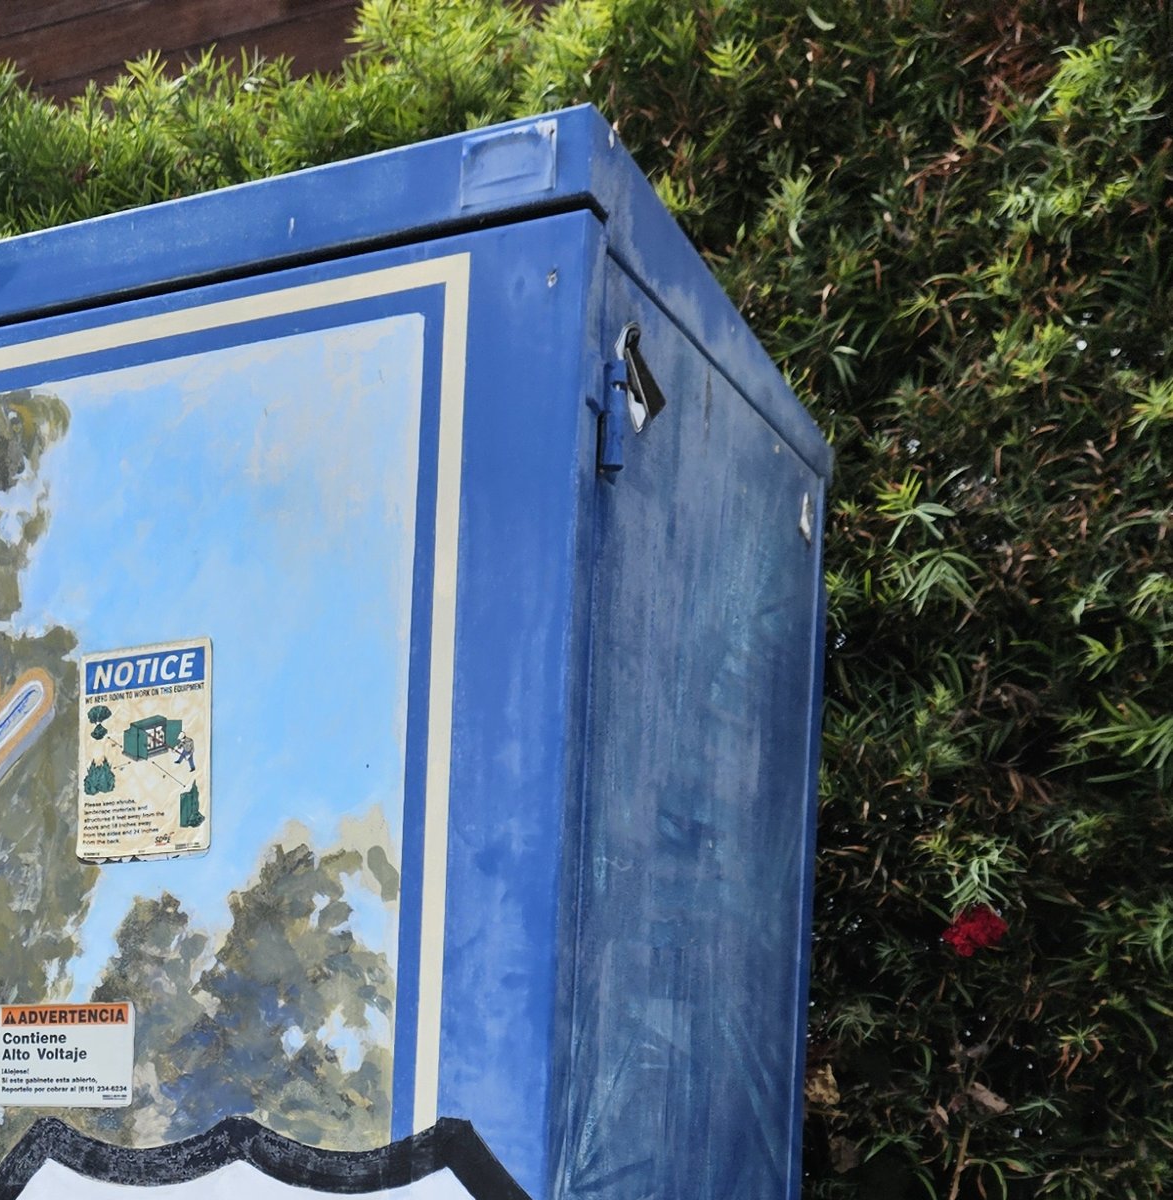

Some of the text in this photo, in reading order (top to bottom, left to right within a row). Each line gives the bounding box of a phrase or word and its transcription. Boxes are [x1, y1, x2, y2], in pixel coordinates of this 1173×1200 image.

[93, 652, 196, 690] NOTICE
[85, 696, 93, 704] WE
[126, 691, 133, 699] TO
[134, 690, 150, 698] WORK
[151, 688, 159, 696] ON
[160, 686, 172, 695] THIS
[173, 682, 205, 693] EQUIPMENT
[18, 1008, 125, 1025] ADVERTENCIA
[2, 1031, 67, 1045] Contiene
[2, 1047, 87, 1063] Alto Voltaje
[25, 1077, 54, 1085] gabinete
[71, 1076, 98, 1084] abierto,
[1, 1086, 33, 1094] Reportelo
[34, 1086, 45, 1094] por
